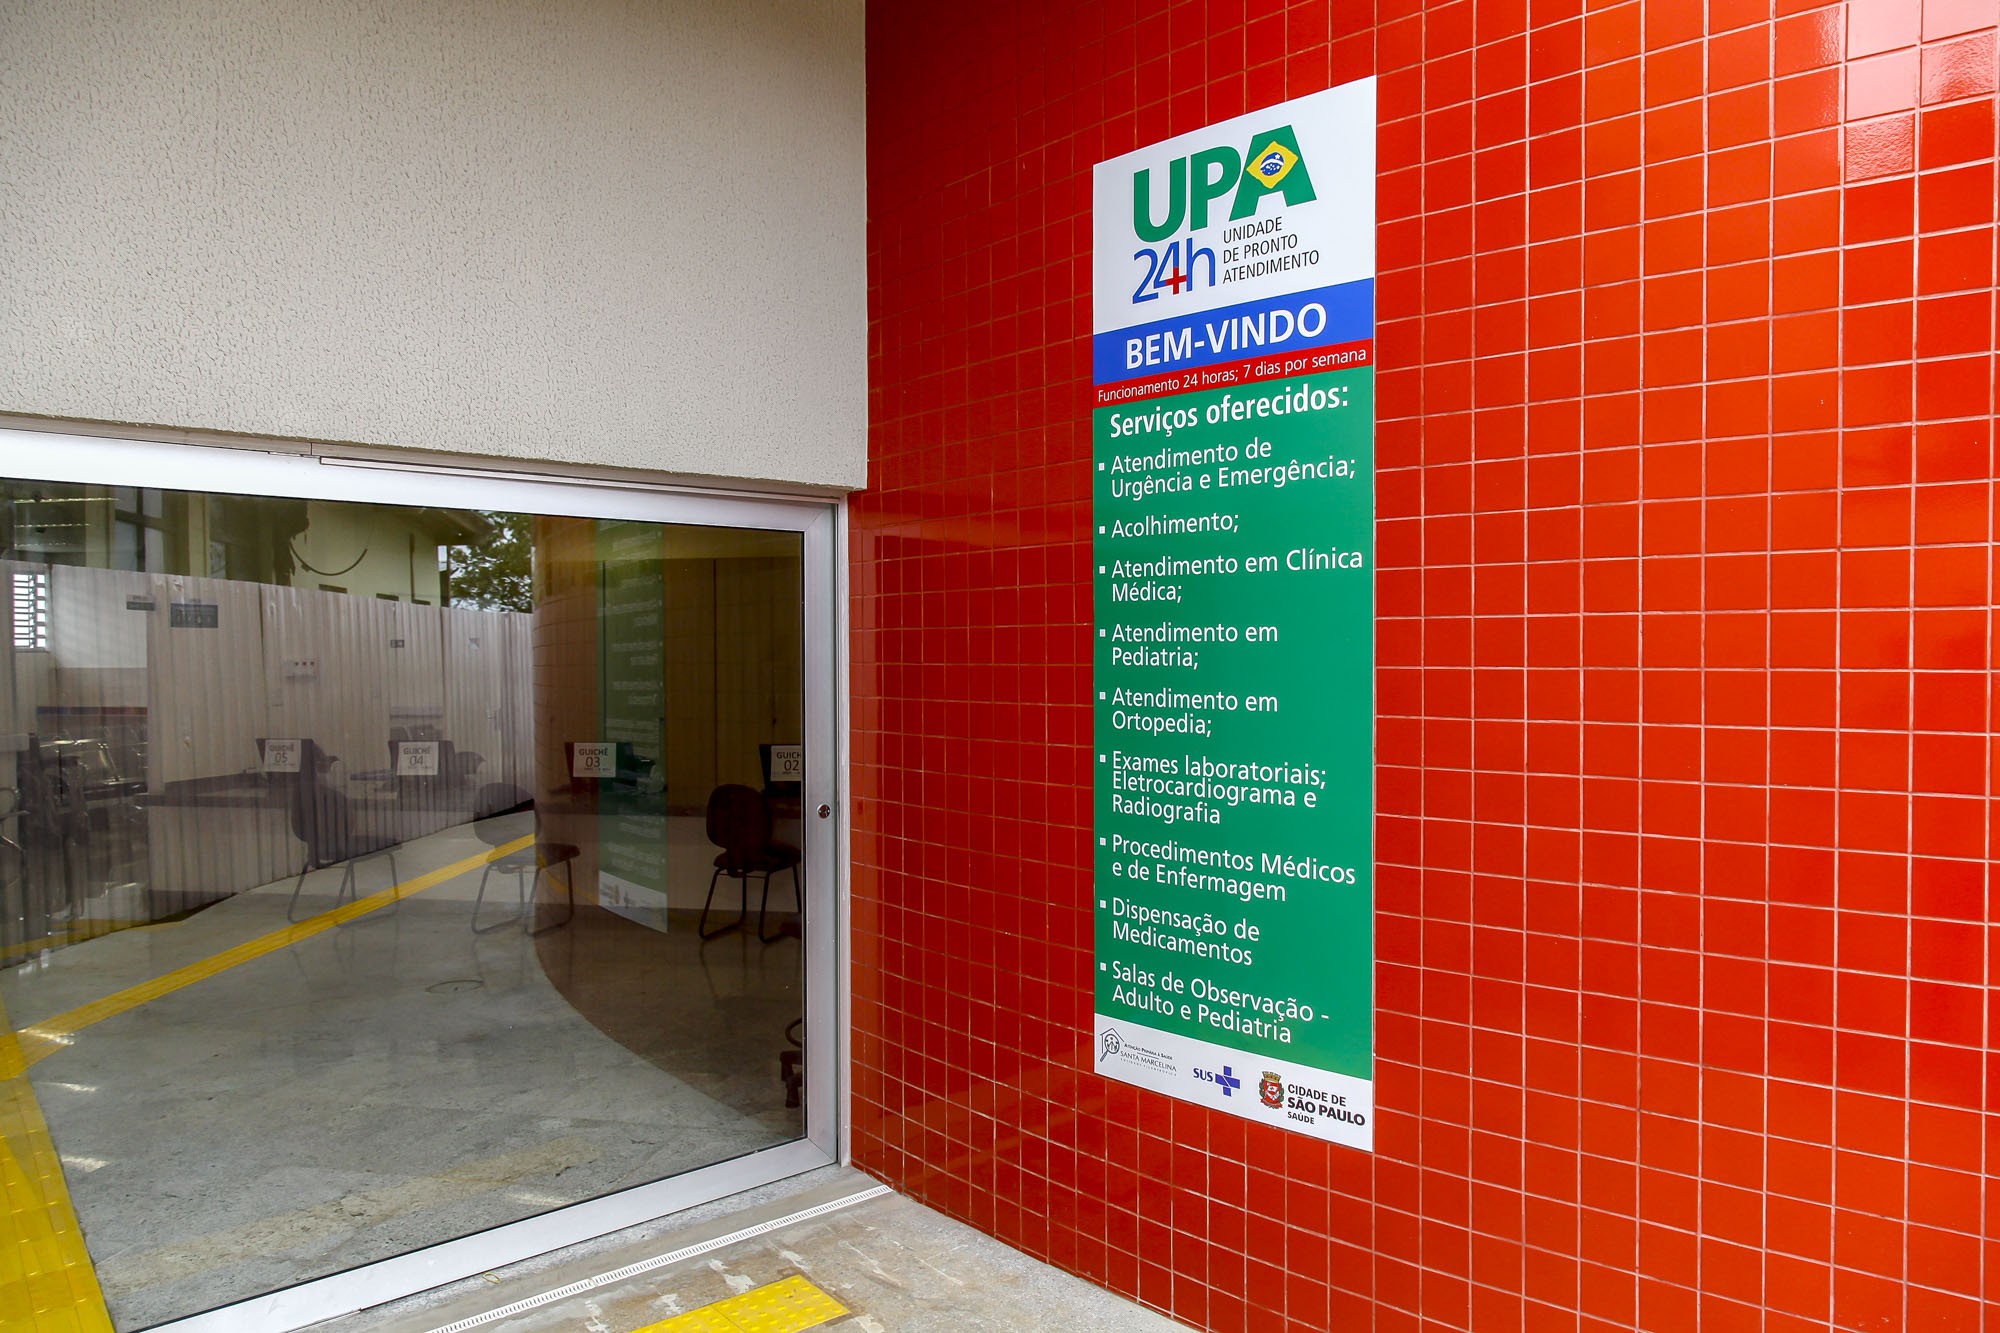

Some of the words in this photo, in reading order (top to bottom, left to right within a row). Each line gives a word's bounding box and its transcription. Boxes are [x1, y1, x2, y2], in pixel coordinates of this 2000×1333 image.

[1133, 125, 1317, 243] UPA
[1223, 216, 1282, 244] UNIDADE
[1223, 248, 1240, 264] DE
[1243, 233, 1298, 260] PRONTO
[1132, 237, 1216, 304] 24h
[1223, 249, 1319, 284] ATENDIMENTO
[1126, 302, 1327, 370] BEM-VINDO
[1098, 378, 1180, 403] Funcionamento
[1183, 375, 1198, 388] 24
[1202, 368, 1239, 385] horas;
[1243, 365, 1251, 378] 7
[1255, 359, 1281, 377] dias
[1285, 358, 1307, 375] por
[1311, 349, 1366, 368] semana
[1110, 406, 1198, 438] Serviços
[1206, 383, 1349, 425] oferecidos:
[1110, 443, 1238, 475] Atendimento
[1246, 437, 1272, 458] de
[1111, 472, 1193, 502] Urgência
[1200, 477, 1210, 489] e
[1218, 455, 1356, 488] Emergência;
[1111, 513, 1239, 539] Acolhimento;
[1111, 555, 1238, 578] Atendimento
[1245, 556, 1278, 573] em
[1286, 547, 1363, 571] Clínica
[1112, 582, 1182, 603] Médica;
[1111, 622, 1238, 643] Atendimento
[1245, 625, 1278, 643] em
[1112, 647, 1199, 670] Pediatria;
[1111, 687, 1238, 711] Atendimento
[1245, 695, 1278, 713] em
[1112, 711, 1212, 738] Ortopedia;
[275, 753, 288, 763] 05
[409, 756, 424, 766] 04
[579, 747, 608, 756] GUICHÊ
[585, 757, 601, 767] 03
[776, 752, 801, 760] GUICH
[784, 760, 800, 771] 02
[1113, 751, 1179, 775] Exames
[1185, 755, 1327, 789] laboratoriais;
[1113, 771, 1296, 807] Eletrocardiograma
[1303, 791, 1317, 809] e
[1113, 794, 1221, 825] Radiografia
[1113, 834, 1254, 872] Procedimentos
[1261, 853, 1356, 885] Médicos
[1112, 861, 1123, 877] e
[1128, 859, 1150, 881] de
[1156, 864, 1287, 903] Enfermagem
[1113, 898, 1227, 937] Dispensação
[1234, 918, 1260, 942] de
[1113, 921, 1252, 966] Medicamentos
[1112, 961, 1156, 988] Salas
[1161, 971, 1185, 994] de
[1190, 977, 1314, 1023] Observação
[1112, 985, 1174, 1016] Adulto
[1180, 1003, 1192, 1021] e
[1198, 1003, 1292, 1044] Pediatria
[1120, 1051, 1140, 1062] SANTA
[1141, 1058, 1177, 1072] MARCELINA
[1193, 1068, 1213, 1082] SUS
[1287, 1084, 1328, 1102] CIDADE
[1332, 1095, 1346, 1107] DE
[1287, 1097, 1316, 1113] SÃO
[1319, 1105, 1366, 1126] PAULO
[1288, 1112, 1315, 1125] SAÚDE
